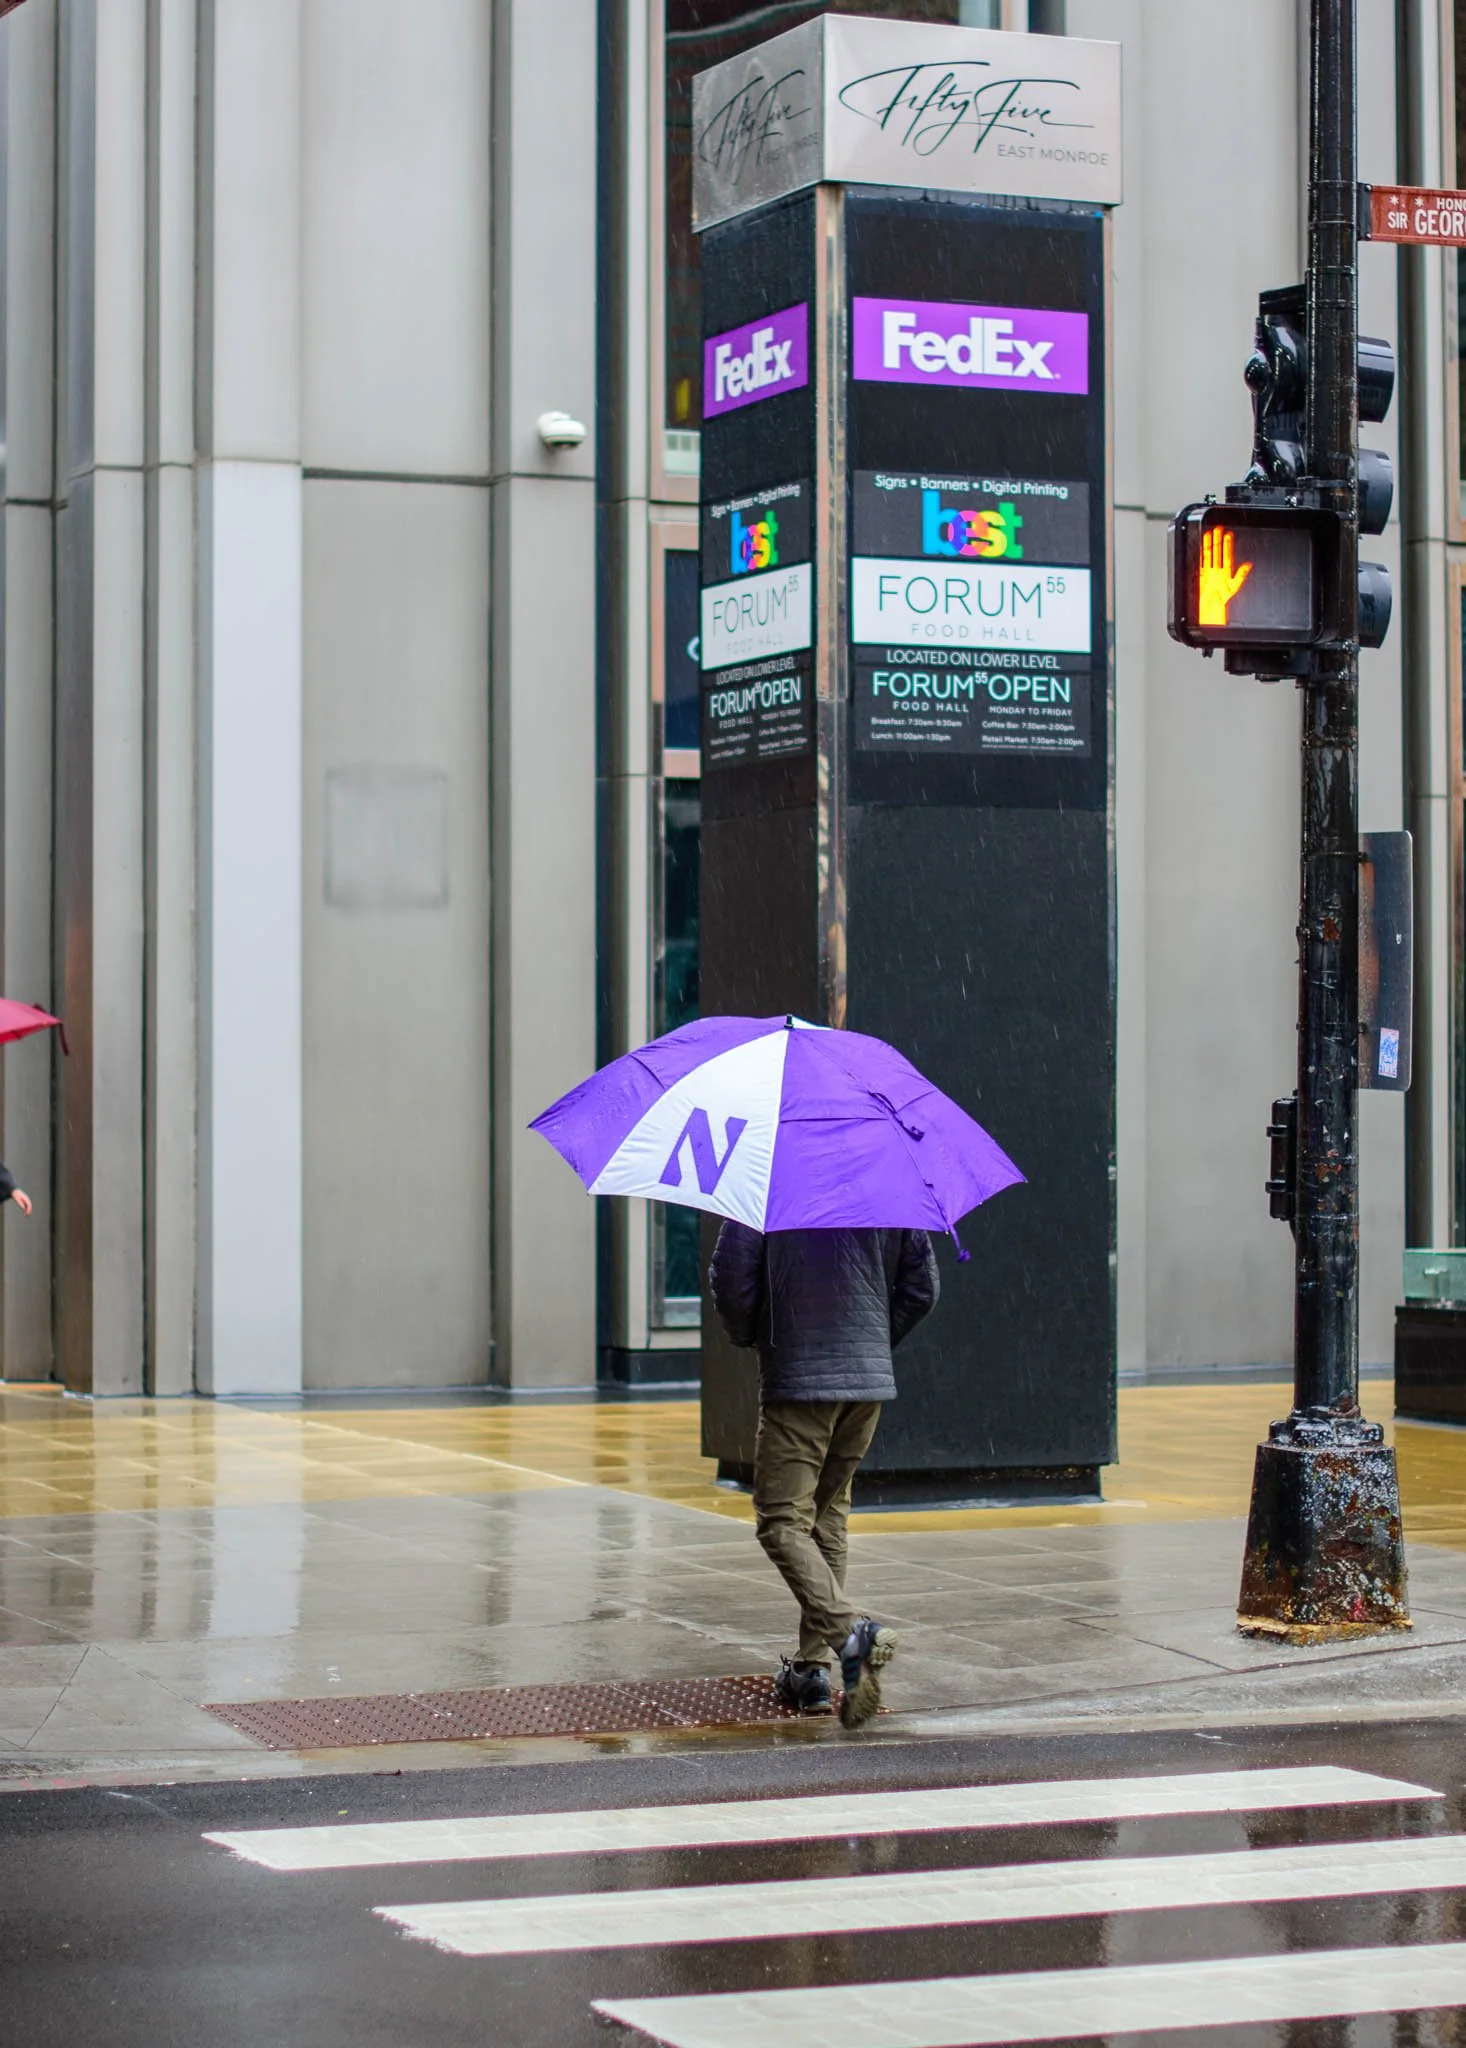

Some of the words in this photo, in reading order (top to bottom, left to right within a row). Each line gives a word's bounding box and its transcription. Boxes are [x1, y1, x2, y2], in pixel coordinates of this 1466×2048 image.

[838, 61, 992, 156] Fifty
[974, 79, 1095, 153] Five
[997, 144, 1036, 159] EAST
[1039, 148, 1109, 166] MONROE
[1387, 211, 1408, 229] SIR
[1415, 209, 1466, 237] GEOR
[714, 327, 795, 402] FedEx
[882, 310, 1058, 380] FedEx
[875, 475, 908, 490] Signs
[920, 477, 970, 492] Banners
[982, 480, 1022, 497] Digital
[1023, 482, 1069, 500] Printing
[730, 510, 779, 575] best
[922, 490, 1024, 560] best
[712, 584, 788, 636] FORUM
[879, 575, 1042, 618] FORUM
[1046, 576, 1066, 594] 55
[912, 623, 970, 639] FOOD
[983, 625, 1035, 642] HALL
[887, 650, 948, 665] LOCATED
[950, 653, 971, 667] ON
[974, 654, 1020, 669] LOWER
[1022, 655, 1061, 670] LEVEL
[710, 687, 756, 718] FORUM
[760, 675, 802, 708] OPEN
[872, 671, 975, 699] FORUM
[974, 672, 988, 685] 55
[987, 674, 1071, 703] OPEN
[893, 701, 930, 712] FOOD
[936, 703, 969, 713] HALL
[989, 706, 1026, 715] MONDAY
[1028, 708, 1039, 716] TO
[1042, 708, 1073, 717] FRIDAY
[659, 1106, 749, 1196] N
